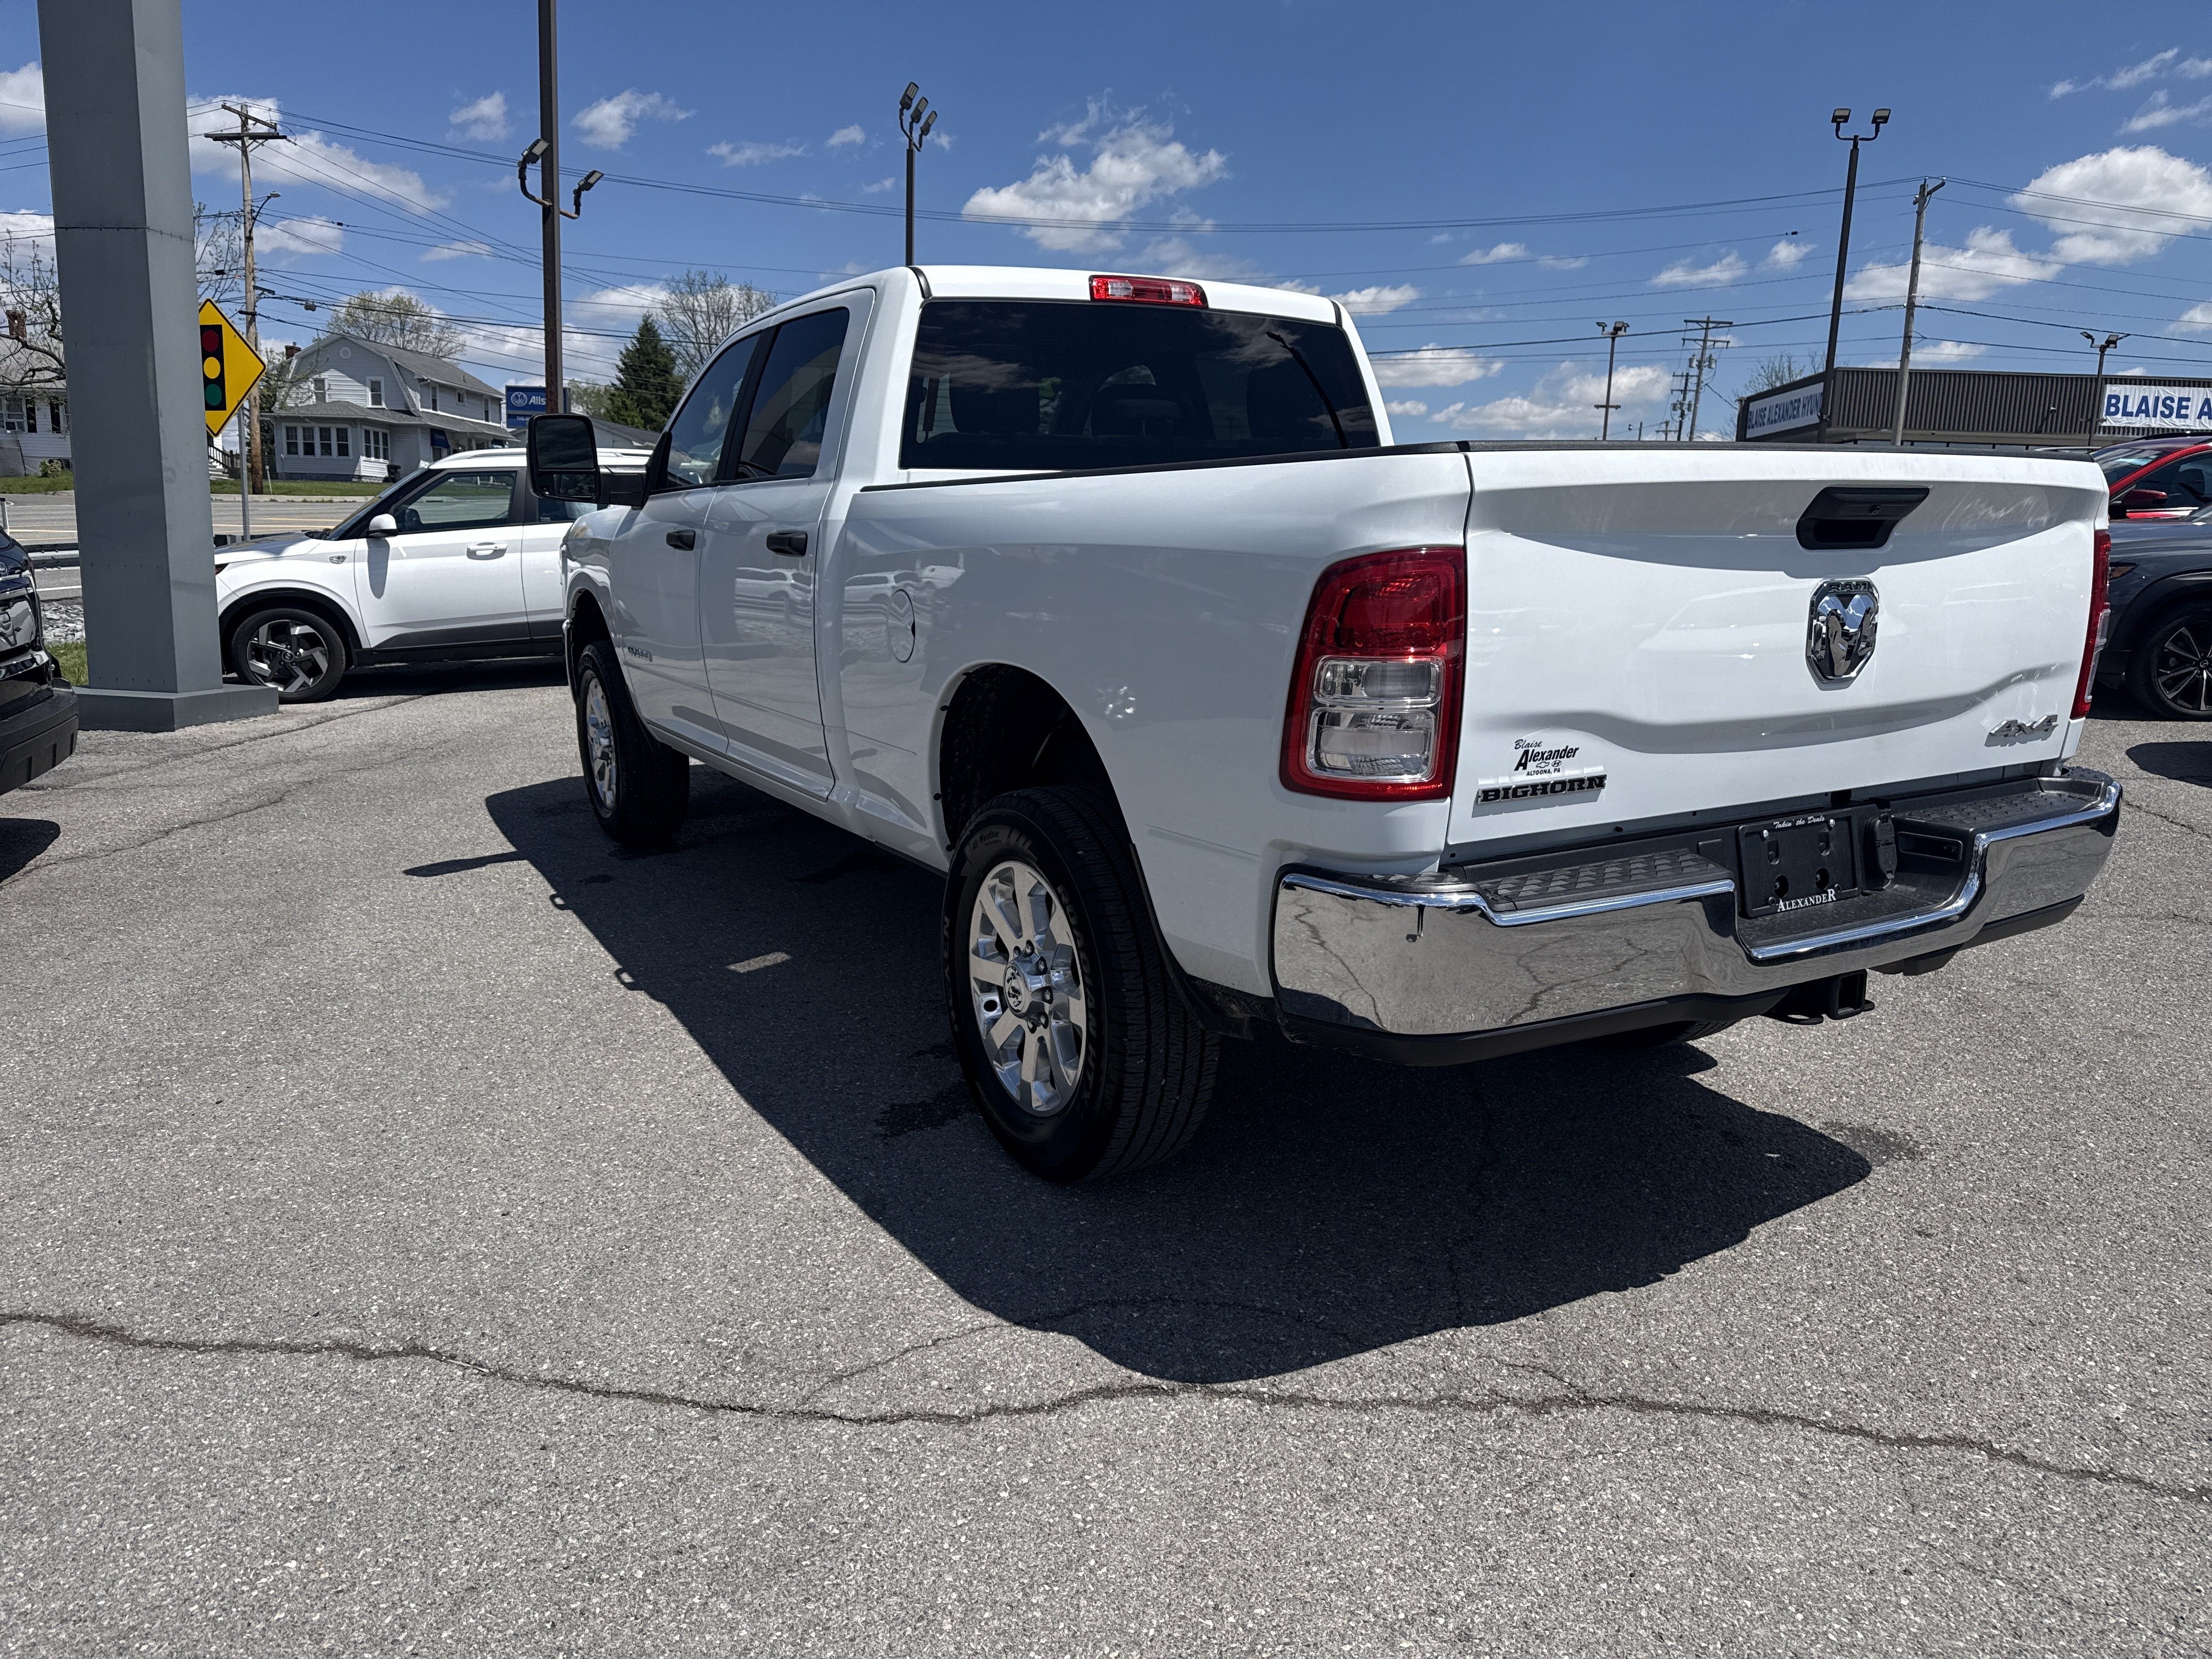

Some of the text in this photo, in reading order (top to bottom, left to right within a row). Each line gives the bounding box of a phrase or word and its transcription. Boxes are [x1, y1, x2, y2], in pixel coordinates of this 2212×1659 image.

[529, 396, 546, 405] Alls
[2105, 394, 2191, 419] BLAISE
[1748, 406, 1767, 430] BLAISE
[1766, 397, 1801, 426] ALEXANDER
[1829, 582, 1869, 592] RAM
[1514, 739, 1543, 750] Blaise
[1514, 746, 1579, 771] Alexander
[1481, 775, 1607, 803] BIGHORN
[1773, 819, 1795, 830] Takin'
[1807, 815, 1825, 824] Deals
